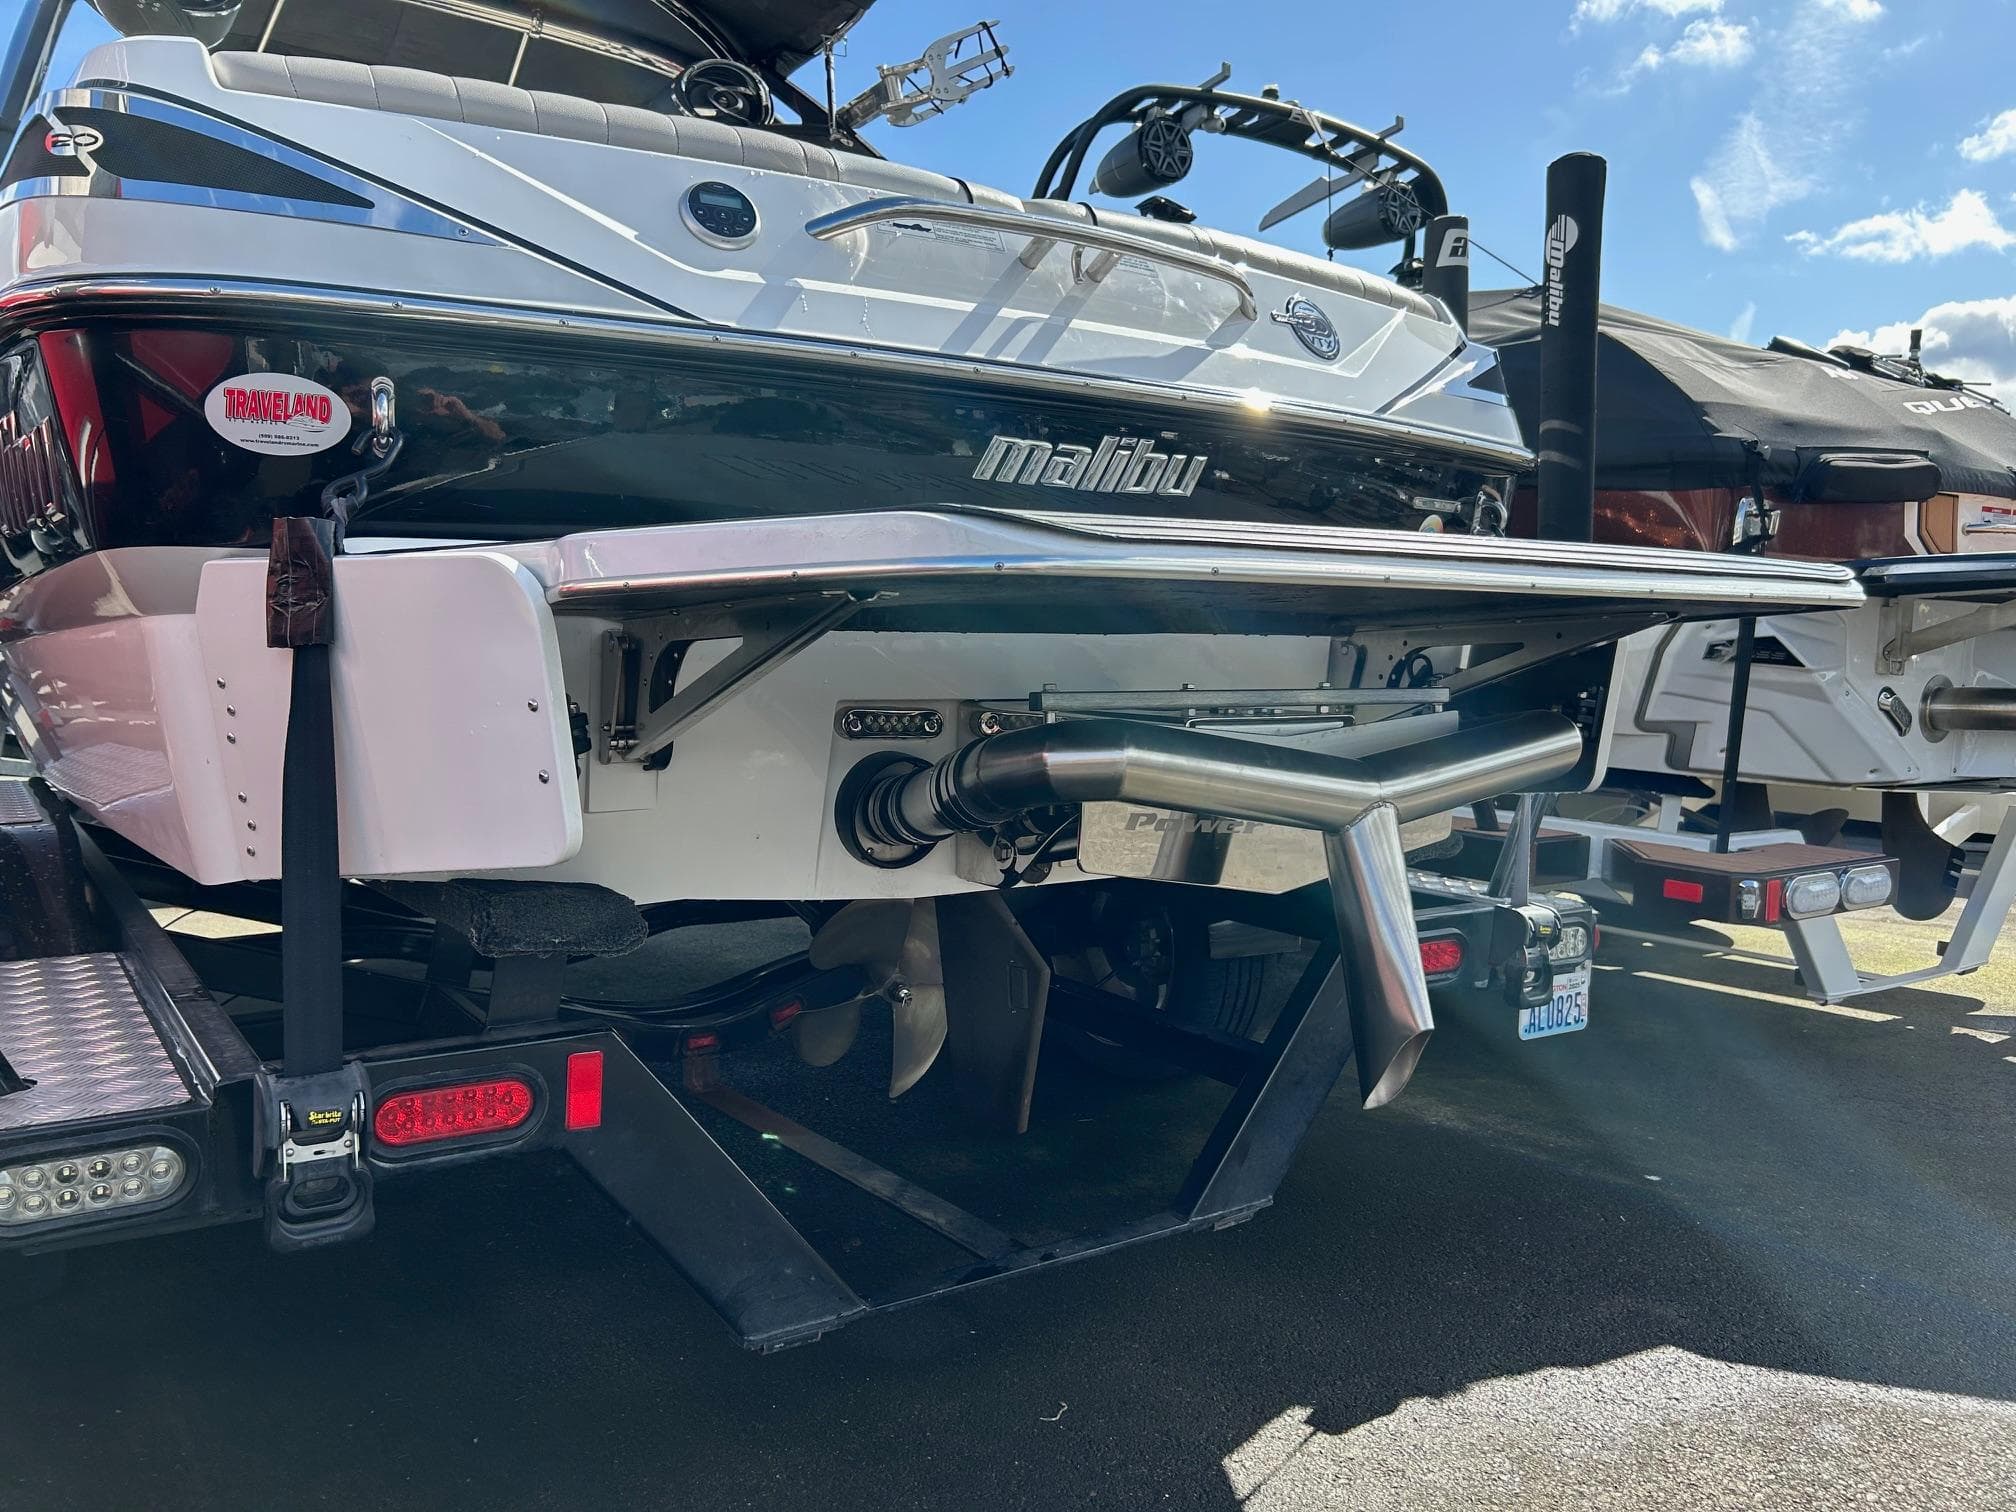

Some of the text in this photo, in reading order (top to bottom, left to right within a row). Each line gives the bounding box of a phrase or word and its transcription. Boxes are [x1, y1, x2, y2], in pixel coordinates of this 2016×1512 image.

[223, 387, 333, 425] TRAVELAND
[972, 435, 1208, 497] malibu
[1124, 812, 1264, 834] Power
